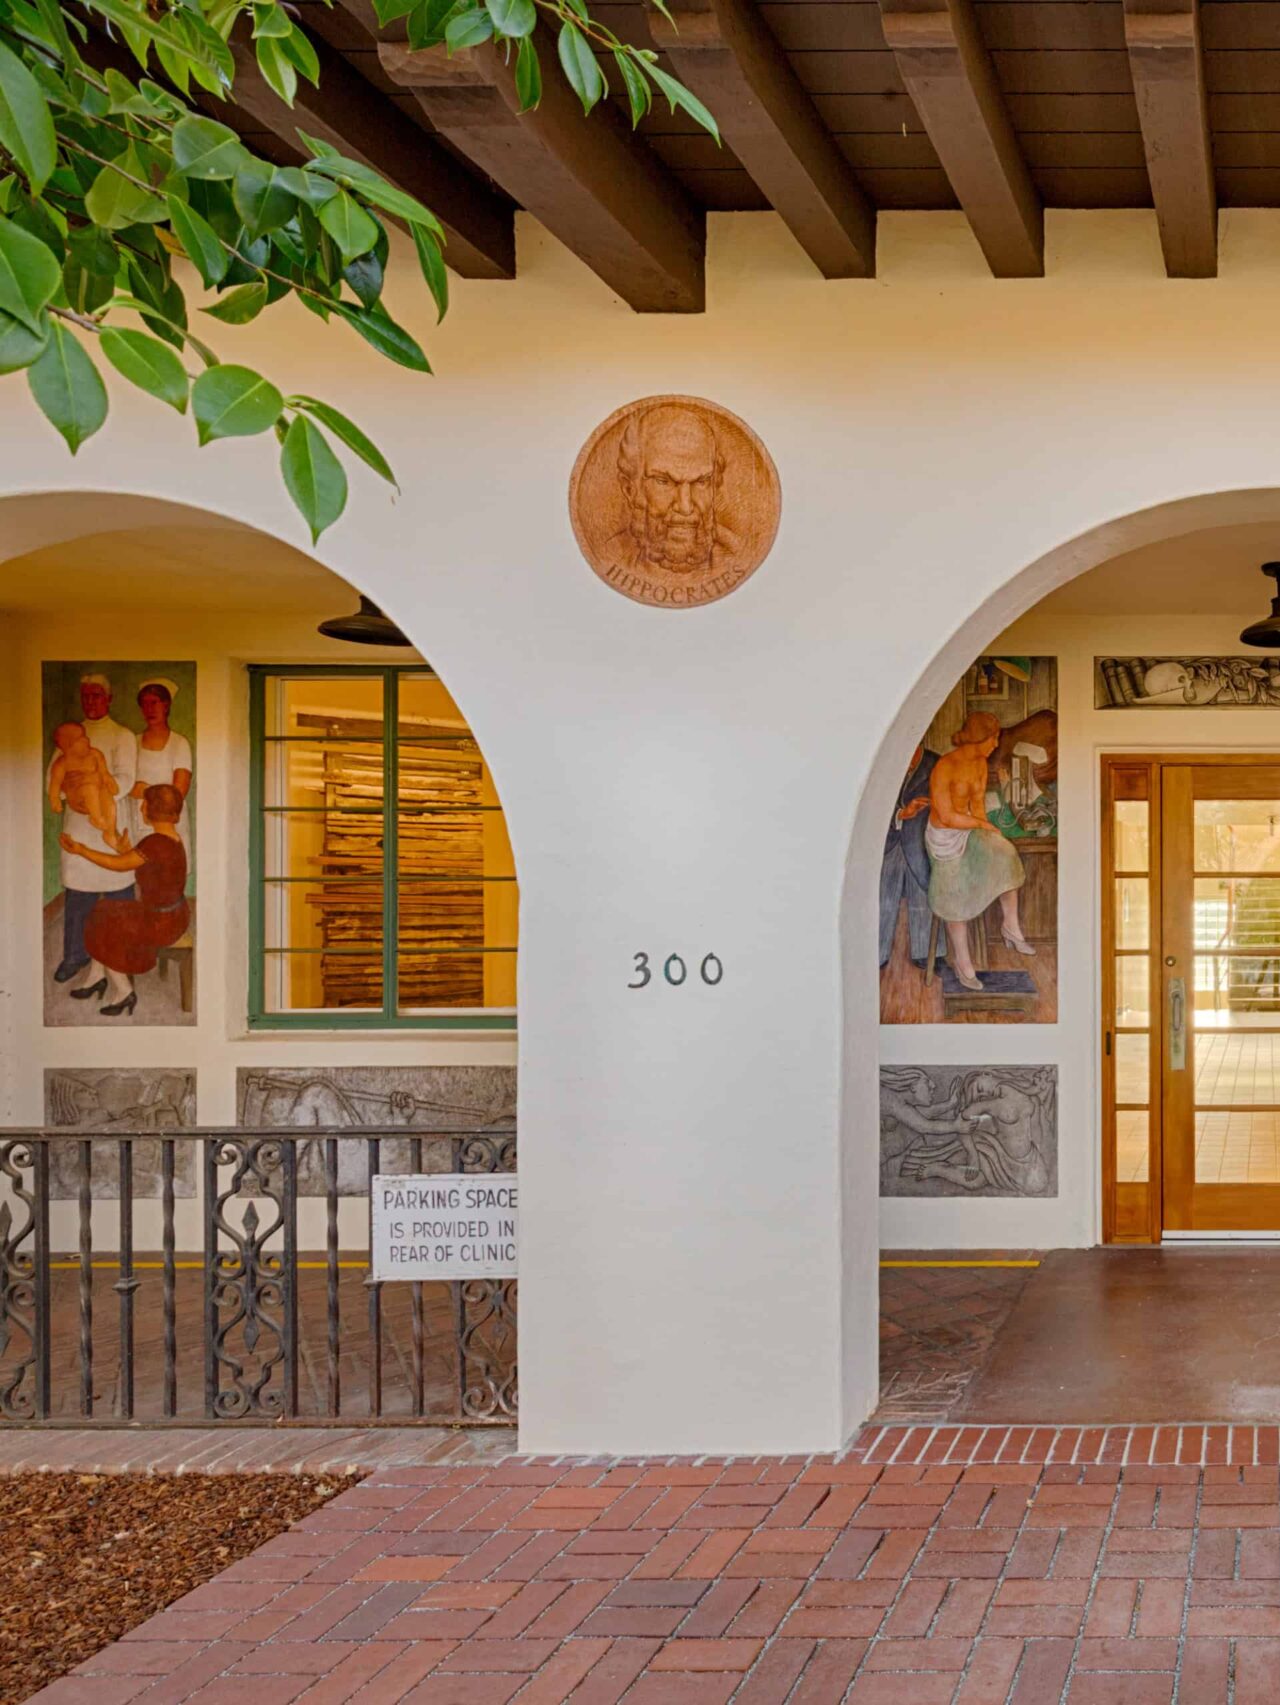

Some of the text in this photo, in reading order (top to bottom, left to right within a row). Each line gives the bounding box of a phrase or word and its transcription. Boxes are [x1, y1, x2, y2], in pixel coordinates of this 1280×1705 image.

[605, 563, 746, 604] HIPPOCRATES
[627, 951, 723, 989] 300
[383, 1188, 518, 1210] PARKING SPACE
[390, 1220, 515, 1239] IS PROVIDED IN
[390, 1243, 516, 1263] REAR OF CLINIC
